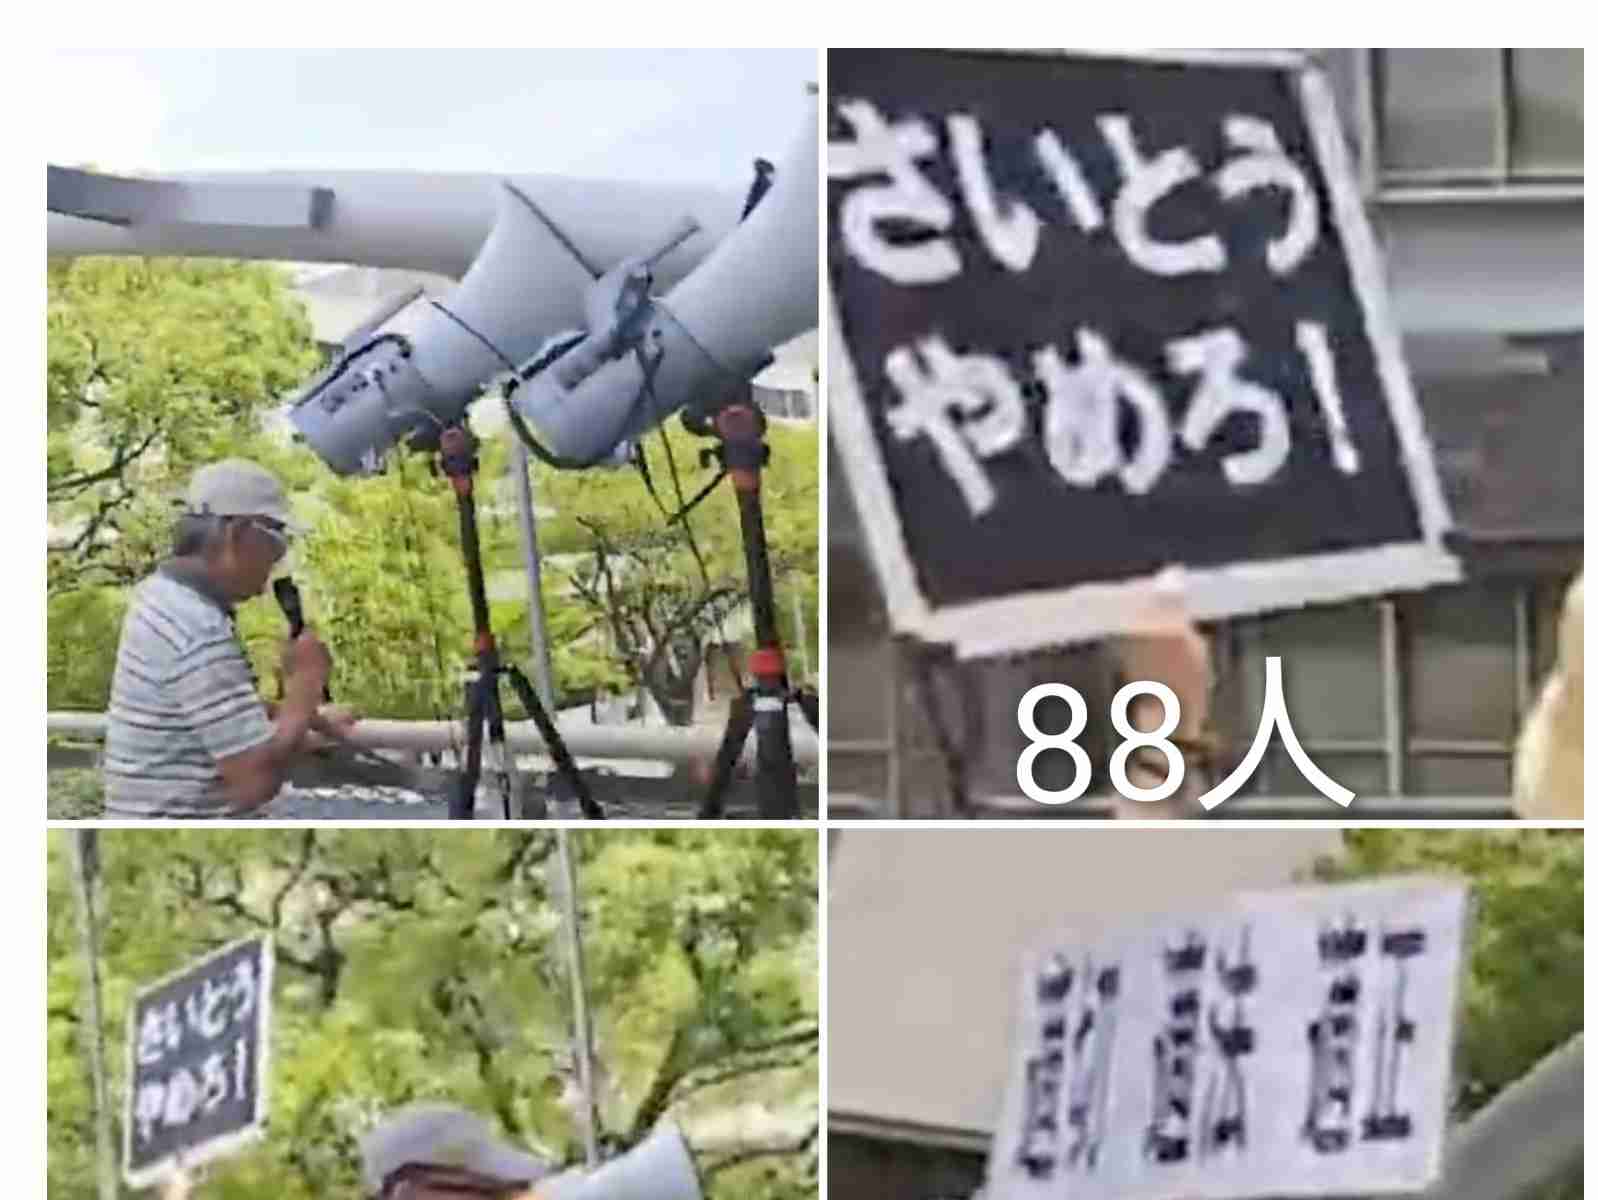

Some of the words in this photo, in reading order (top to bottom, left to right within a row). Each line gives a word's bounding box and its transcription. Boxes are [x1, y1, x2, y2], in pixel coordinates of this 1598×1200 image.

[827, 99, 1319, 284] さいとう
[138, 958, 255, 1066] さいとう
